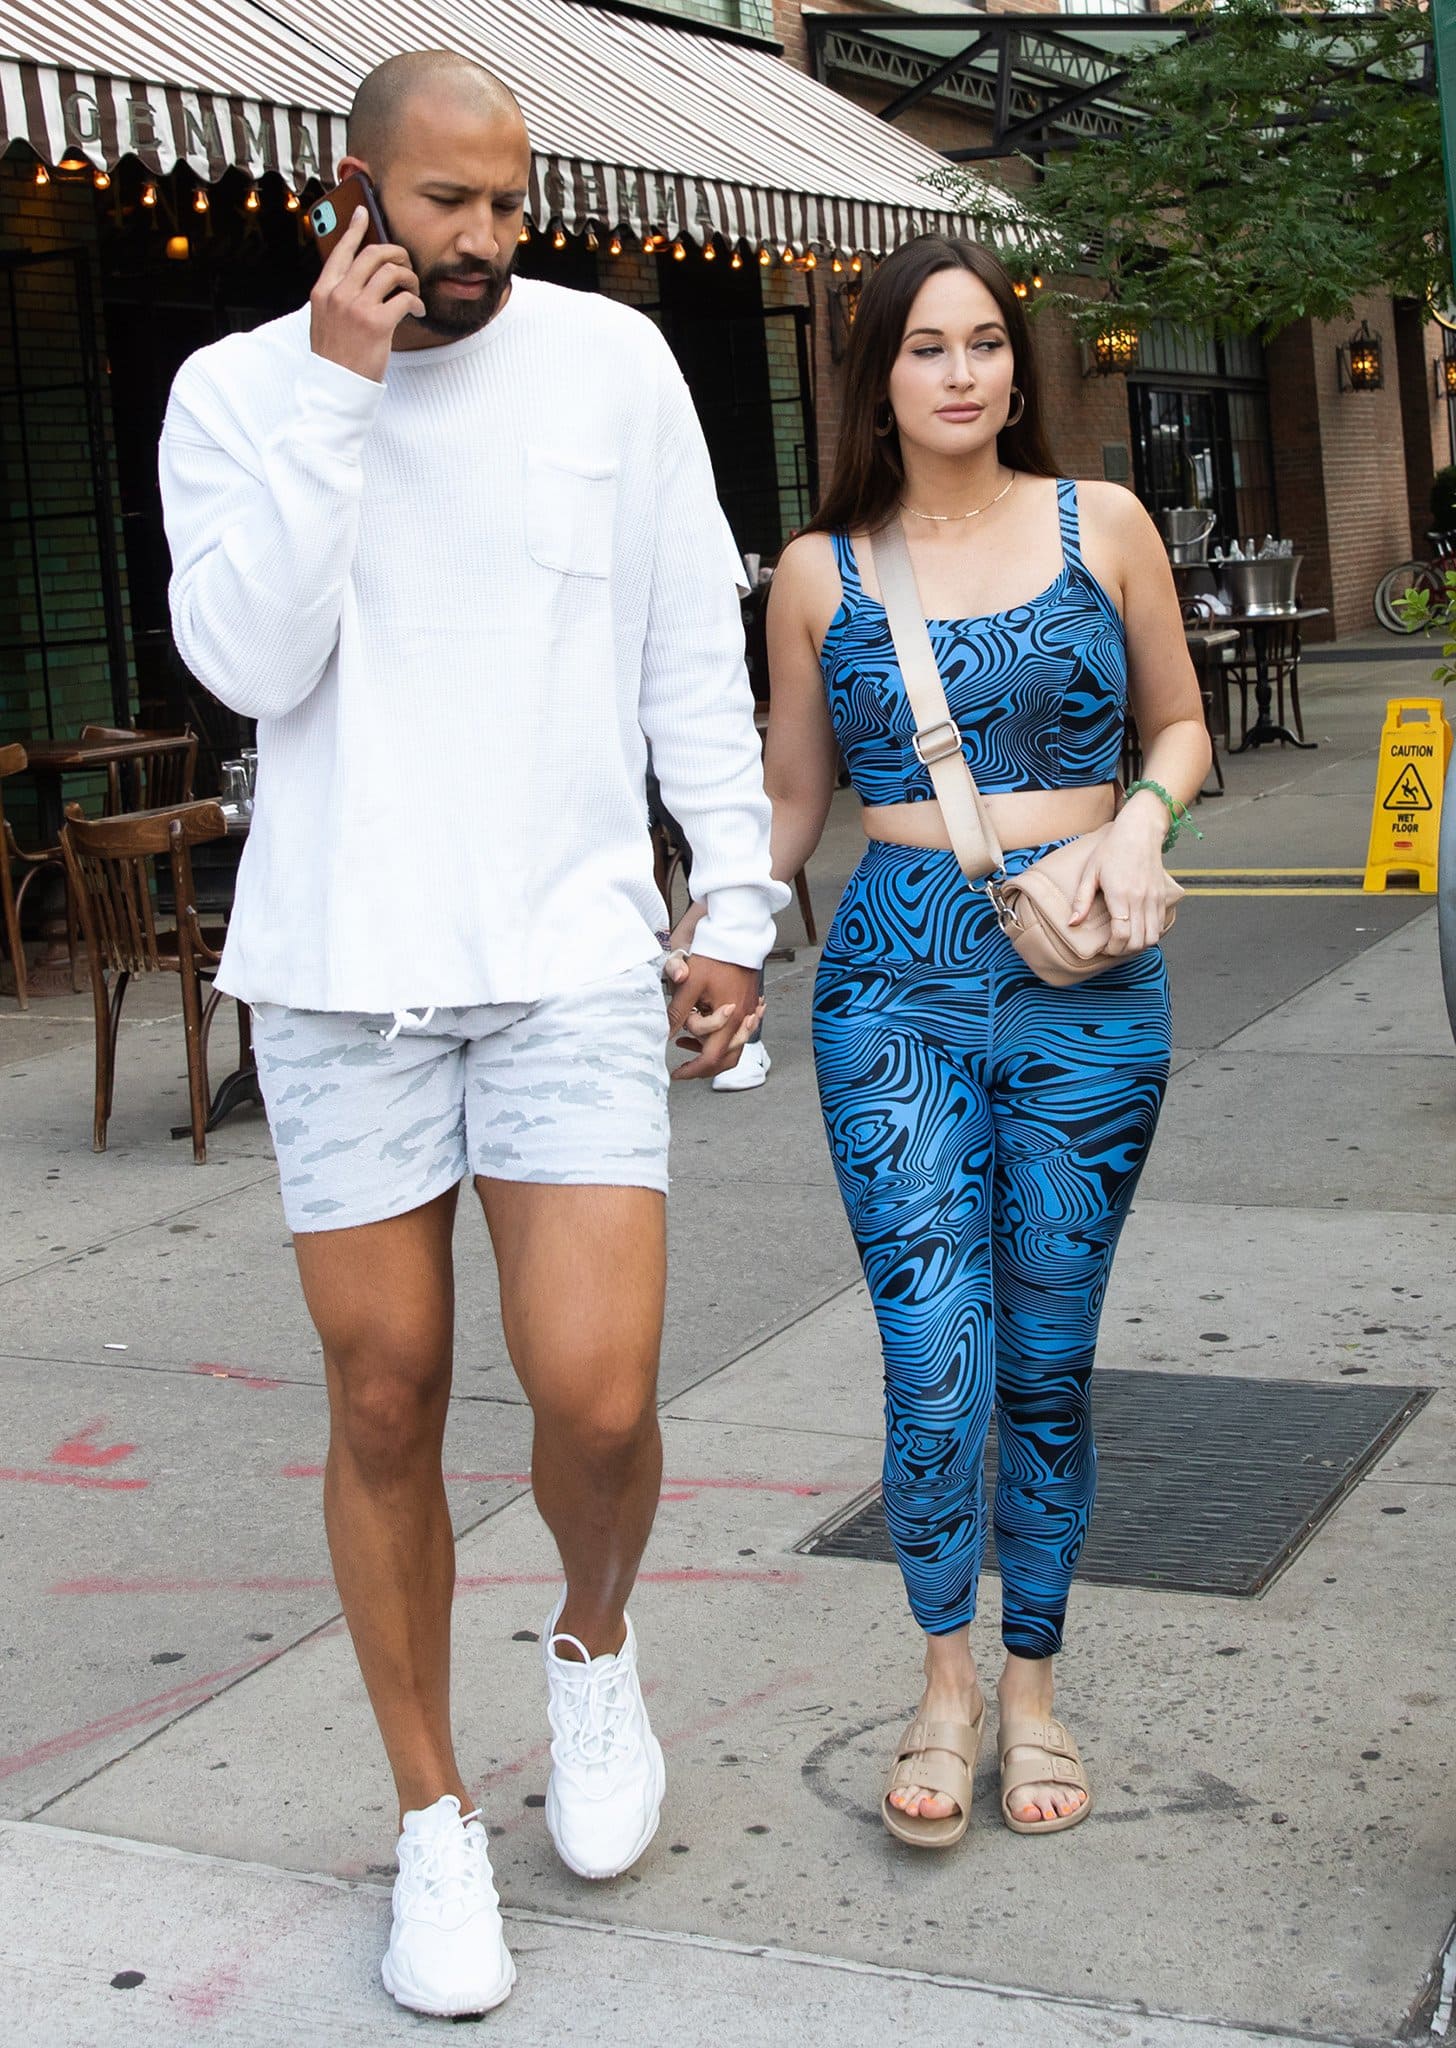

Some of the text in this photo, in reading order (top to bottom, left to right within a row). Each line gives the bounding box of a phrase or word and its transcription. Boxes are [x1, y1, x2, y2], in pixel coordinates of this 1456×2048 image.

[65, 90, 320, 173] GEMMA
[1391, 745, 1434, 757] CAUTION
[1397, 813, 1415, 823] WET
[1392, 823, 1419, 833] FLOOR
